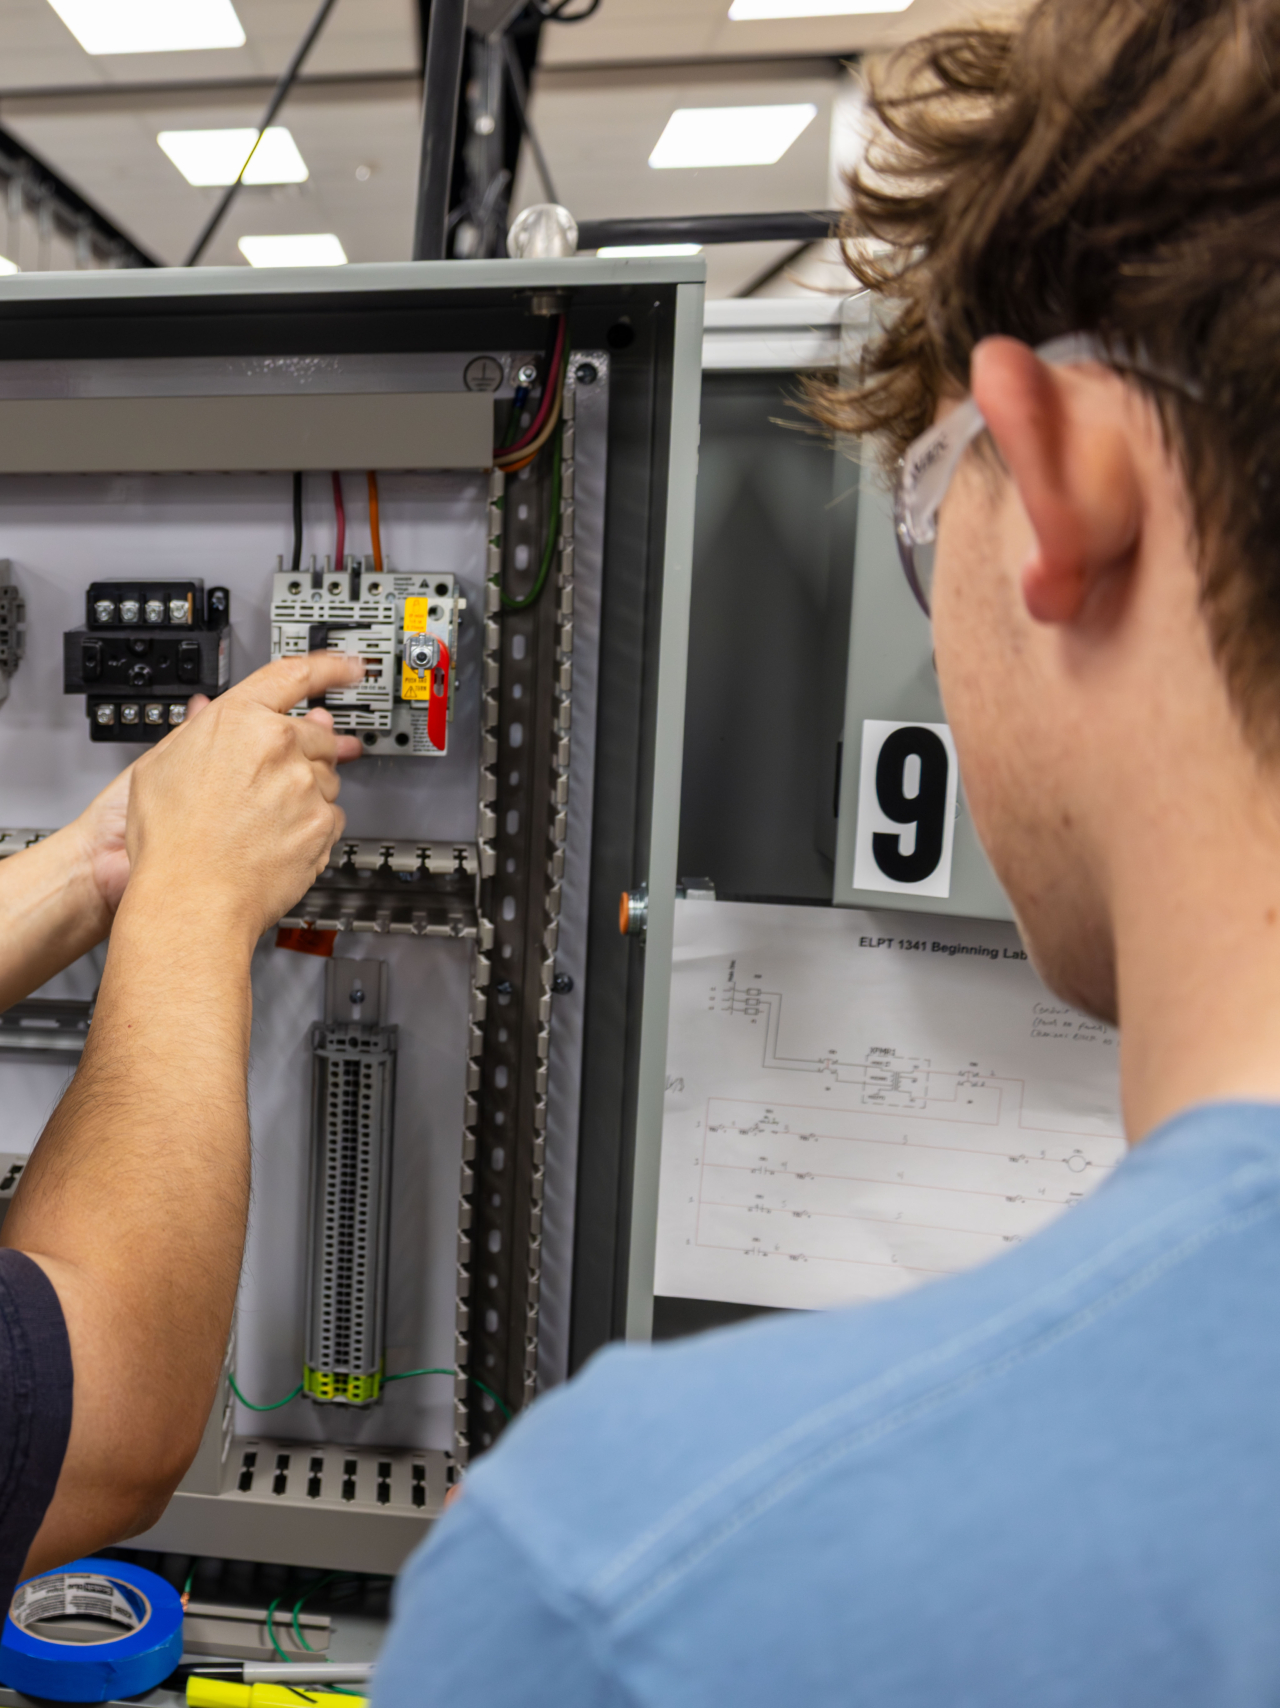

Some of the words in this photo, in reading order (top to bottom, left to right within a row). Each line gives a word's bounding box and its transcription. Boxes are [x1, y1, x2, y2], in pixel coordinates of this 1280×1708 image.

[872, 726, 949, 883] 9
[859, 936, 894, 950] ELPT
[898, 939, 927, 952] 1341
[930, 941, 999, 960] Beginning
[1002, 948, 1028, 961] Lab
